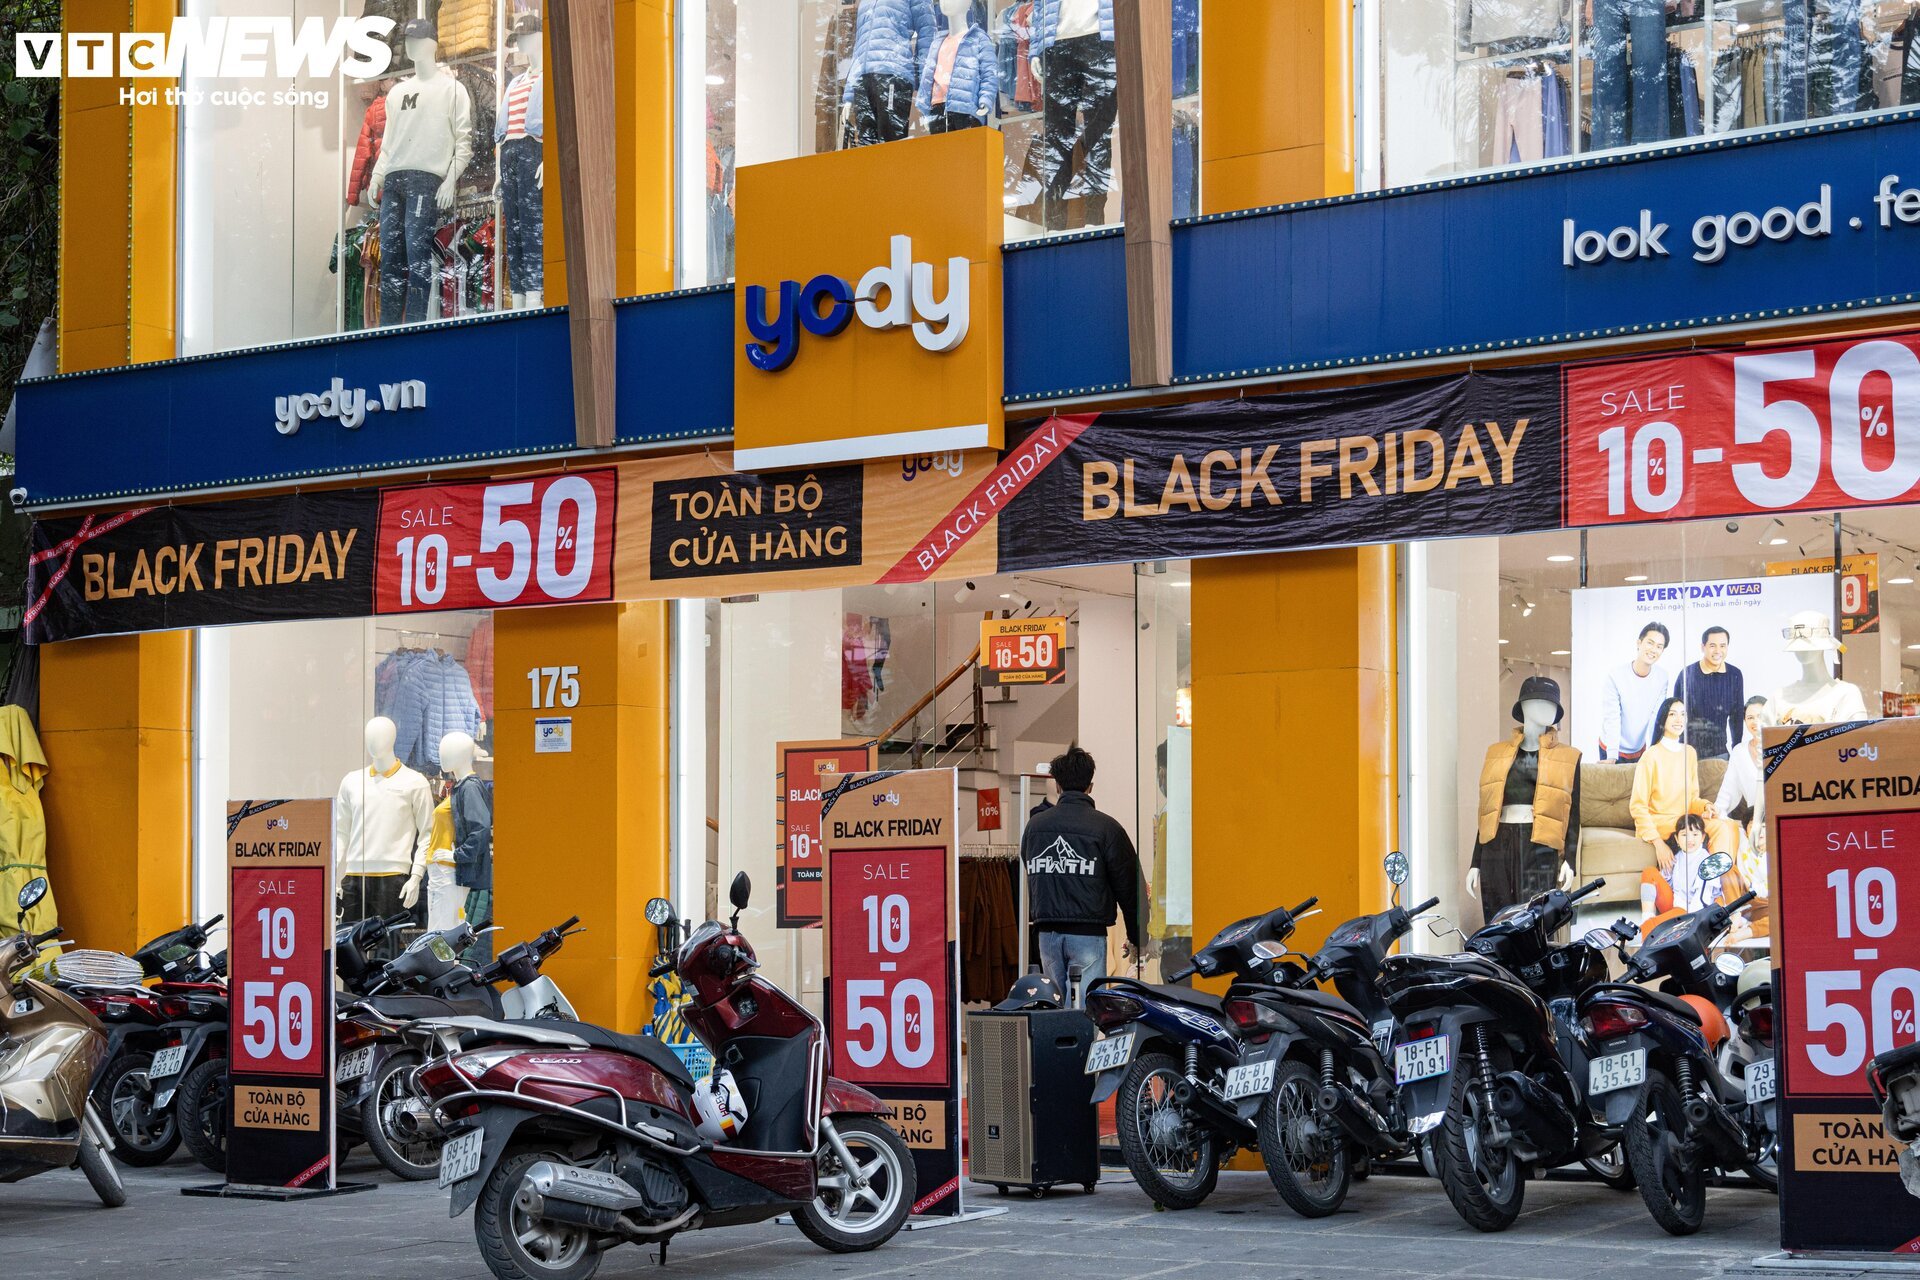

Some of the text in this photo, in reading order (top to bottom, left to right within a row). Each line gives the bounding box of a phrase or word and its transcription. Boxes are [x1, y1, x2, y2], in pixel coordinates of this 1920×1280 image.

[401, 92, 419, 110] M
[1563, 209, 1670, 267] look
[1692, 183, 1832, 265] good
[745, 235, 970, 372] yody
[275, 377, 426, 434] yody.vn
[1600, 385, 1686, 416] SALE
[1082, 419, 1530, 521] BLACK FRIDAY
[670, 474, 823, 521] TOÀN BỘ
[917, 425, 1060, 571] BLACK FRIDAY
[88, 516, 124, 538] BLACK FRIDAY
[400, 506, 454, 528] SALE
[669, 517, 848, 567] CỬA HÀNG
[83, 528, 358, 601] BLACK FRIDAY
[1637, 583, 1760, 601] EVERYDAY WEAR
[1000, 625, 1022, 633] BLACK
[1023, 624, 1047, 632] FRIDAY
[527, 665, 580, 709] 175
[1804, 722, 1857, 744] BLACK FRIDAY
[1767, 730, 1803, 774] BLACK FRIDAY
[1838, 742, 1878, 762] yody
[849, 773, 887, 790] BLACK FRIDAY
[1782, 779, 1857, 803] BLACK
[872, 790, 900, 806] yody
[266, 816, 288, 830] yody
[790, 824, 810, 832] SALE
[833, 818, 942, 838] BLACK FRIDAY
[235, 841, 321, 857] BLACK FRIDAY
[1826, 829, 1896, 850] SALE
[863, 863, 910, 880] SALE
[258, 880, 296, 895] SALE
[1095, 1038, 1127, 1056] 34-K1
[1404, 1040, 1438, 1062] 18-F1
[1088, 1050, 1127, 1072] 078.87
[1399, 1055, 1445, 1081] 470.91
[1598, 1052, 1636, 1074] 18-G1
[1234, 1063, 1267, 1082] 18-B1
[1592, 1067, 1642, 1092] 435.43
[1226, 1077, 1269, 1098] 846.02
[1751, 1079, 1776, 1101] 169
[248, 1089, 305, 1109] TOÀN BỘ
[244, 1107, 310, 1126] CỬA HÀNG
[903, 1103, 926, 1124] BỘ
[900, 1125, 933, 1143] ÀNG
[1819, 1118, 1884, 1138] TOÀN
[447, 1133, 475, 1161] 89-E1
[1812, 1143, 1900, 1165] CỬA HÀ
[441, 1152, 477, 1184] 327.40
[914, 1181, 957, 1213] BLACK FRIDAY
